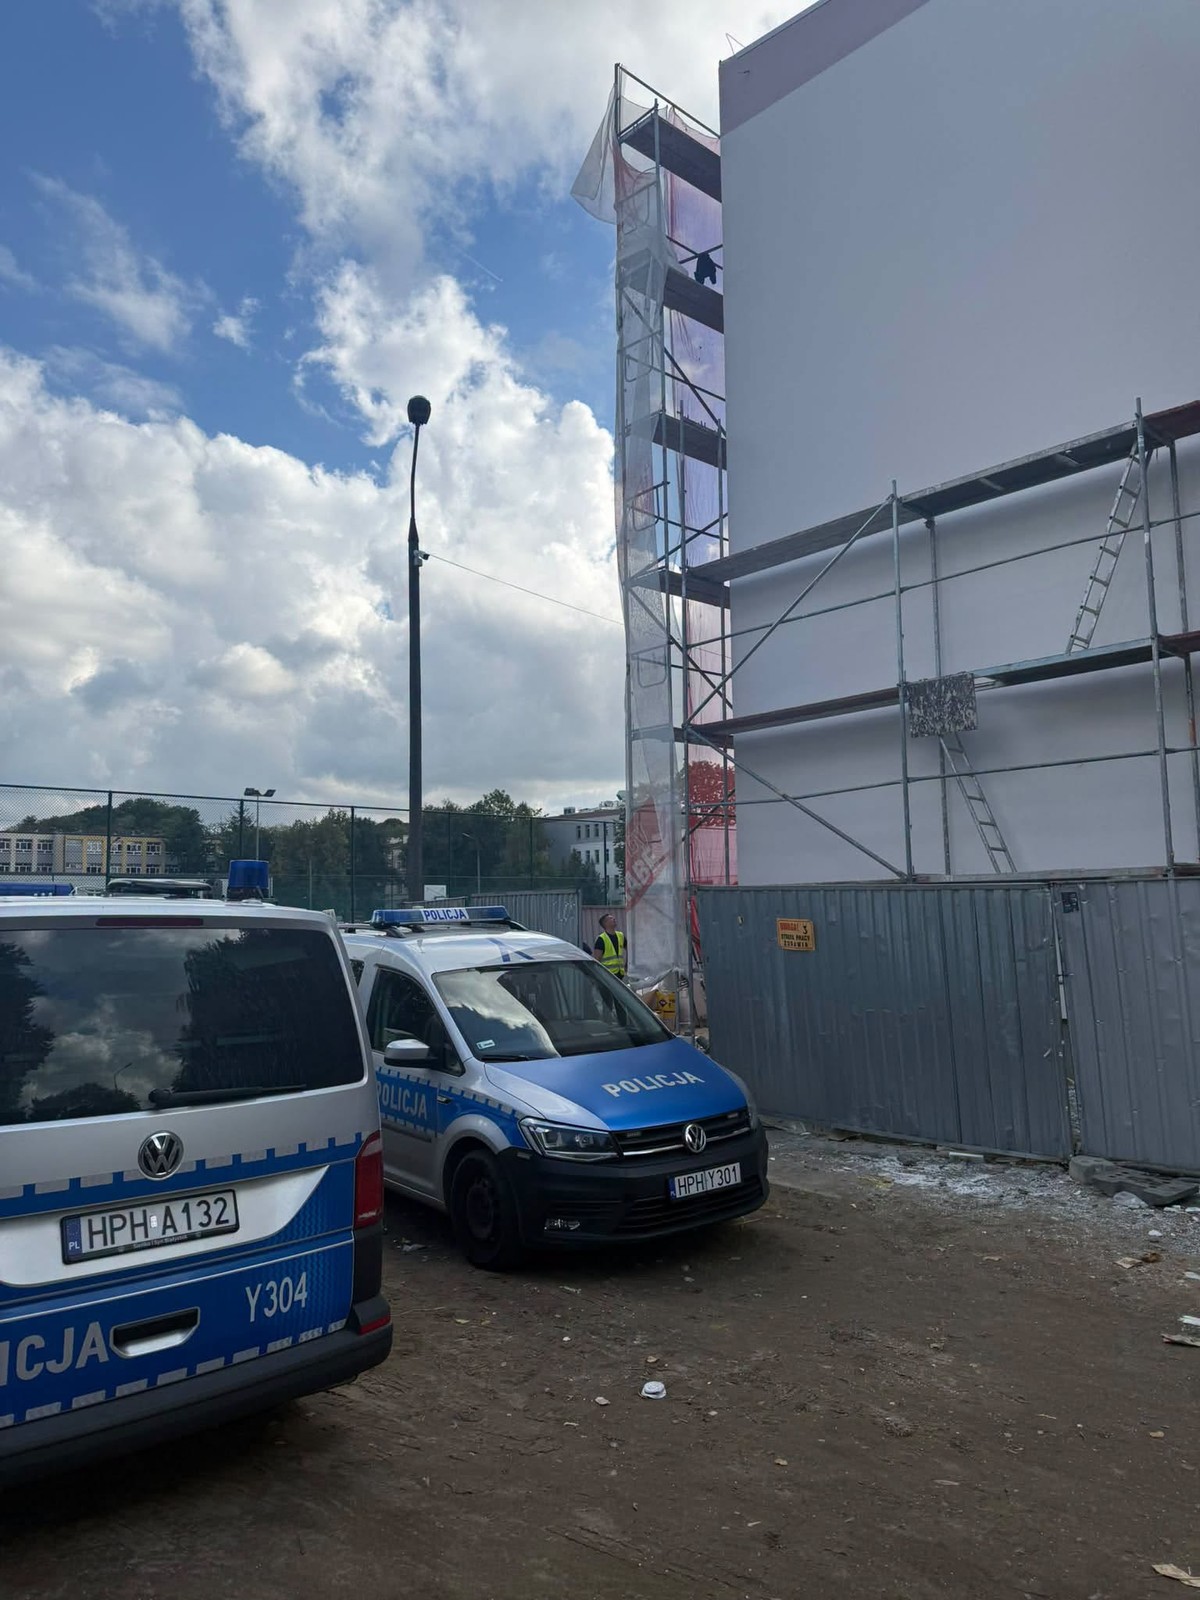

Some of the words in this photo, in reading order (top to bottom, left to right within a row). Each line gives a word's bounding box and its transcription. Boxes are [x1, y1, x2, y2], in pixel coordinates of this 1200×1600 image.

[423, 908, 467, 921] POLICJA
[600, 1071, 705, 1097] POLICJA
[677, 1173, 704, 1196] HPH
[707, 1166, 738, 1188] Y301
[87, 1209, 150, 1249] HPH
[161, 1197, 229, 1236] A132
[68, 1241, 80, 1250] PL
[245, 1272, 308, 1322] Y304
[0, 1321, 110, 1387] ICJA
